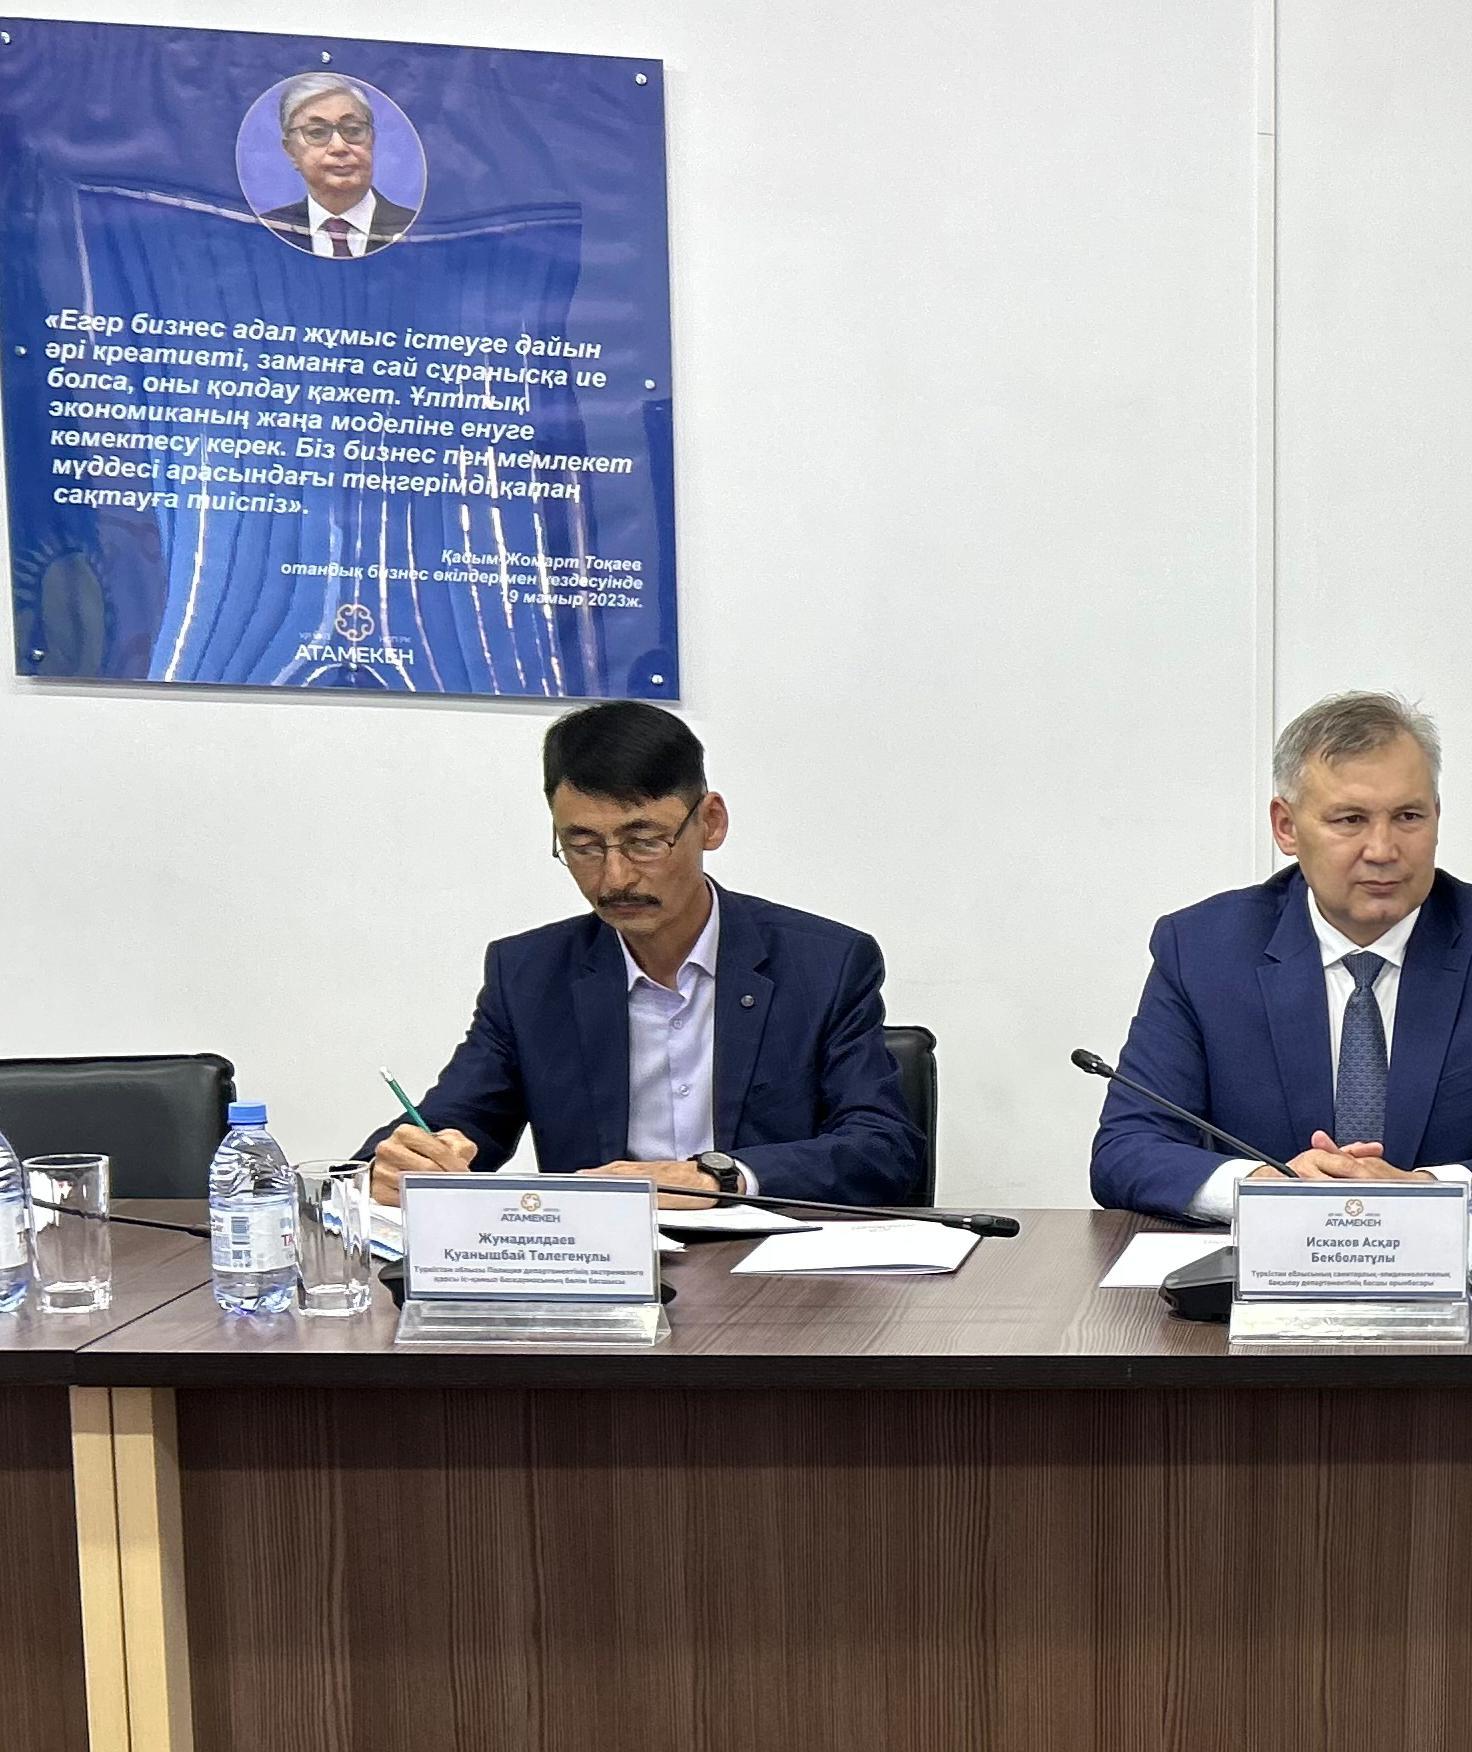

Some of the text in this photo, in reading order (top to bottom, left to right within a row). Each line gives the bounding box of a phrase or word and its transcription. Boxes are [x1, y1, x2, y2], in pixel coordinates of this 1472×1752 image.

[45, 309, 602, 360] «Егер бизнес адал жұмыс істеуге дайын
[45, 340, 606, 388] әрі креативті, заманға сай сұранысқа ие
[47, 367, 526, 415] болса, оны қолдау қажет. Ұлттық
[49, 400, 535, 443] экономиканың жаңа моделіне енуге
[50, 430, 633, 475] көмектесу керек. Біз бизнес пен мемлекет
[52, 455, 160, 480] мүддесі
[166, 464, 334, 488] арасындағы
[54, 487, 308, 515] сақтауға тиіспіз».
[281, 562, 364, 580] отандық
[367, 564, 429, 580] бизнес
[586, 555, 643, 573] Тоқаев
[588, 593, 643, 608] 2023ж.
[295, 645, 414, 664] АТАМЕКЕН
[500, 1213, 560, 1223] АТАМЕКЕН
[1325, 1218, 1381, 1227] АТАМЕКЕН
[478, 1232, 576, 1246] Жумадилдаев
[1362, 1237, 1400, 1251] Асқар
[444, 1248, 526, 1264] Қуанышбай
[1311, 1252, 1395, 1265] Бекболатұлы
